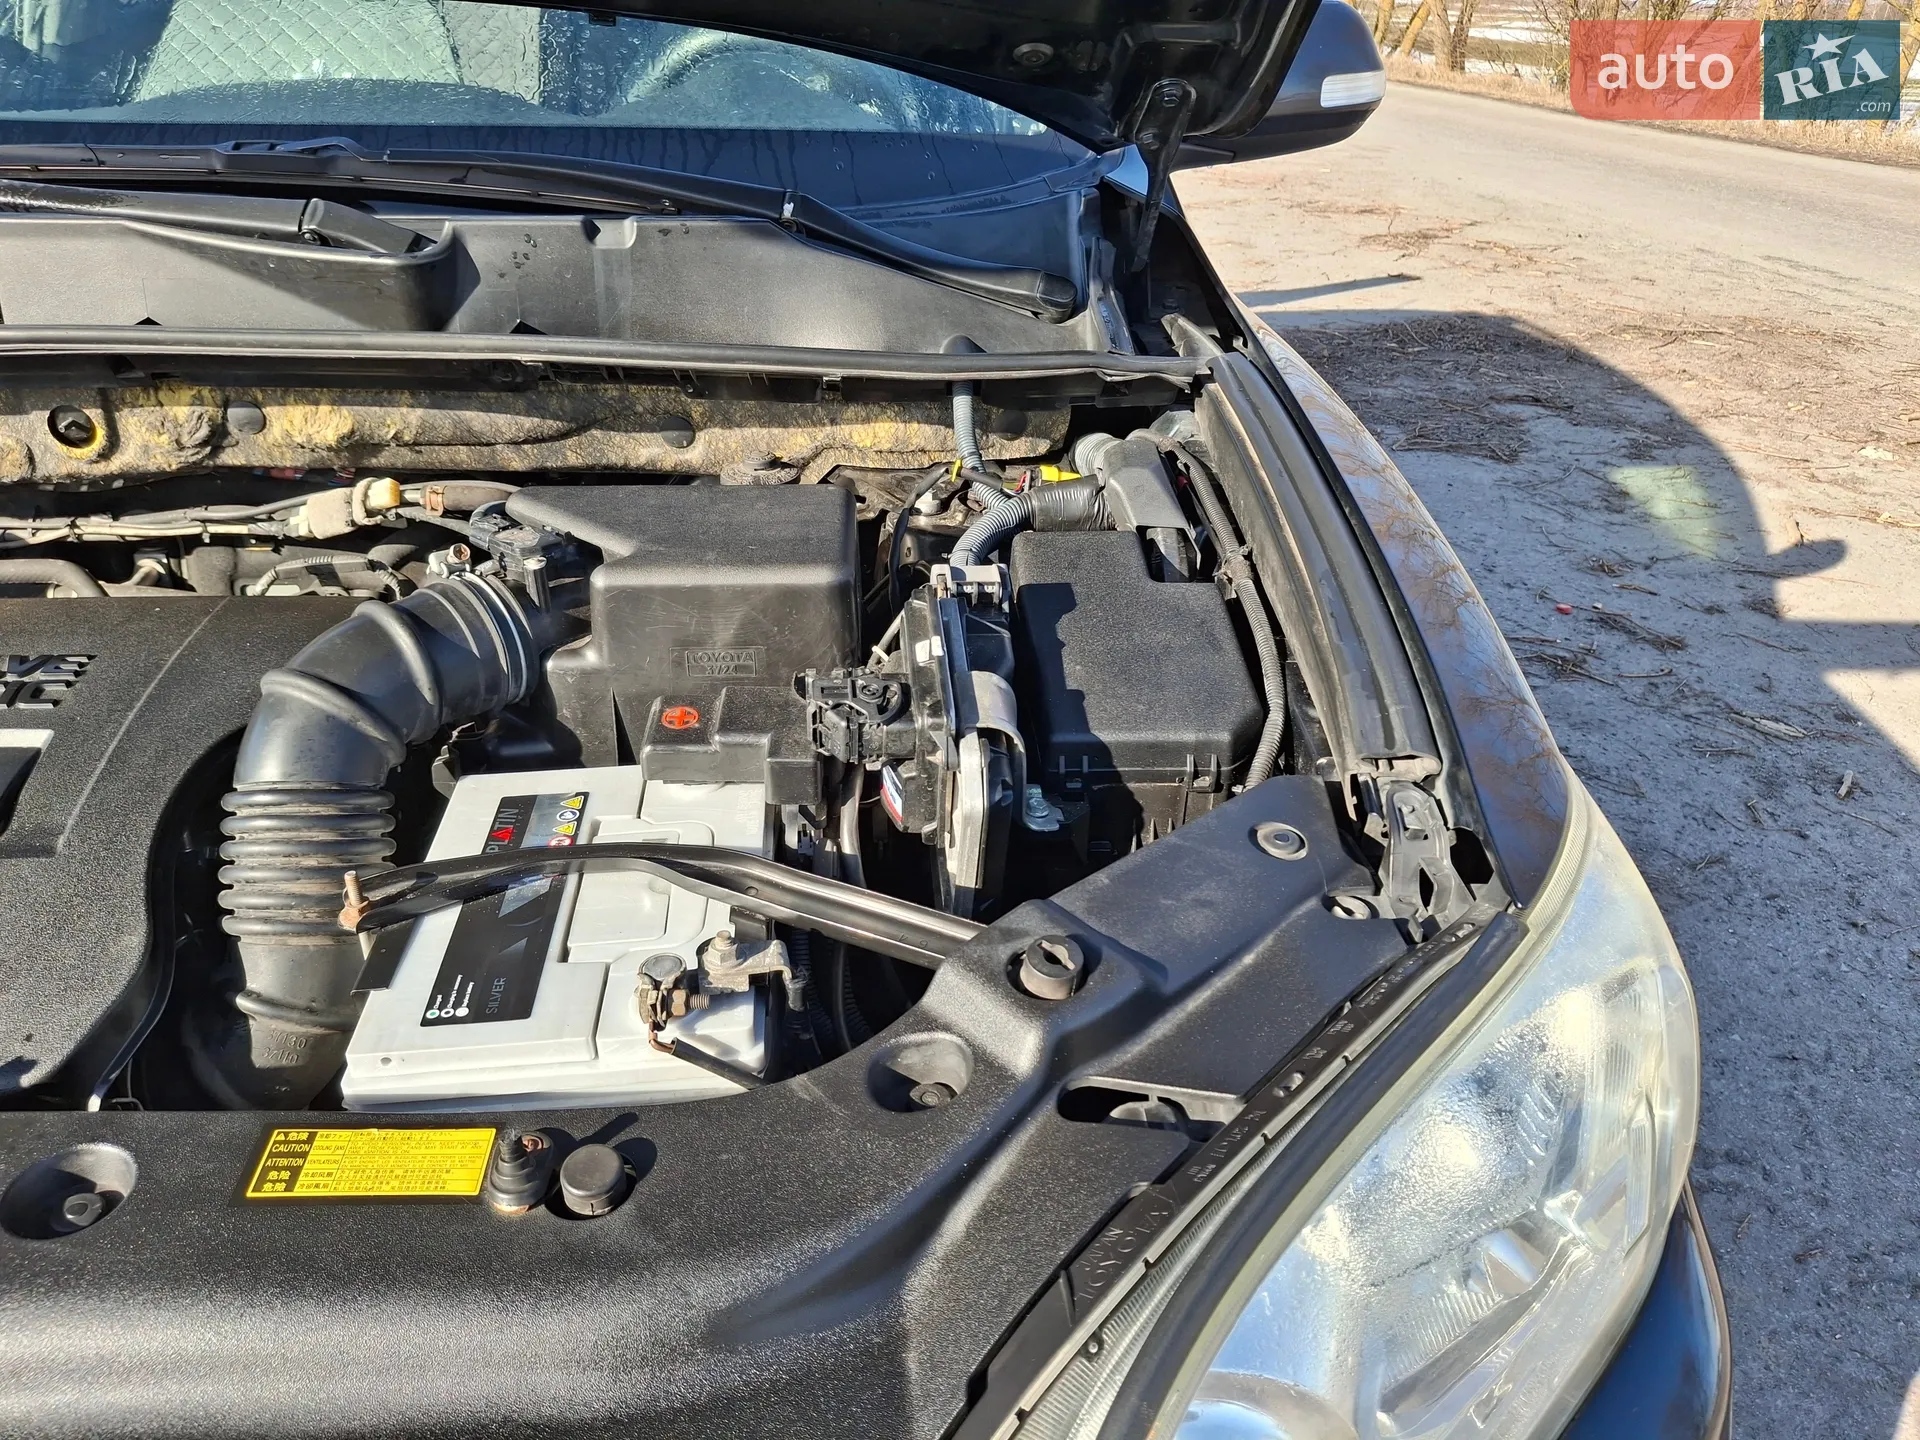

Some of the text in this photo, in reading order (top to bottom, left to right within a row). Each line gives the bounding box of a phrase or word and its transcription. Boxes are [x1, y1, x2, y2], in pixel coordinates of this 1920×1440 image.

[692, 651, 755, 663] TOYOTA
[486, 977, 507, 1014] SILVER
[272, 1143, 312, 1153] CAUTION
[265, 1157, 305, 1168] ATTENTION
[267, 1170, 291, 1180] 危险
